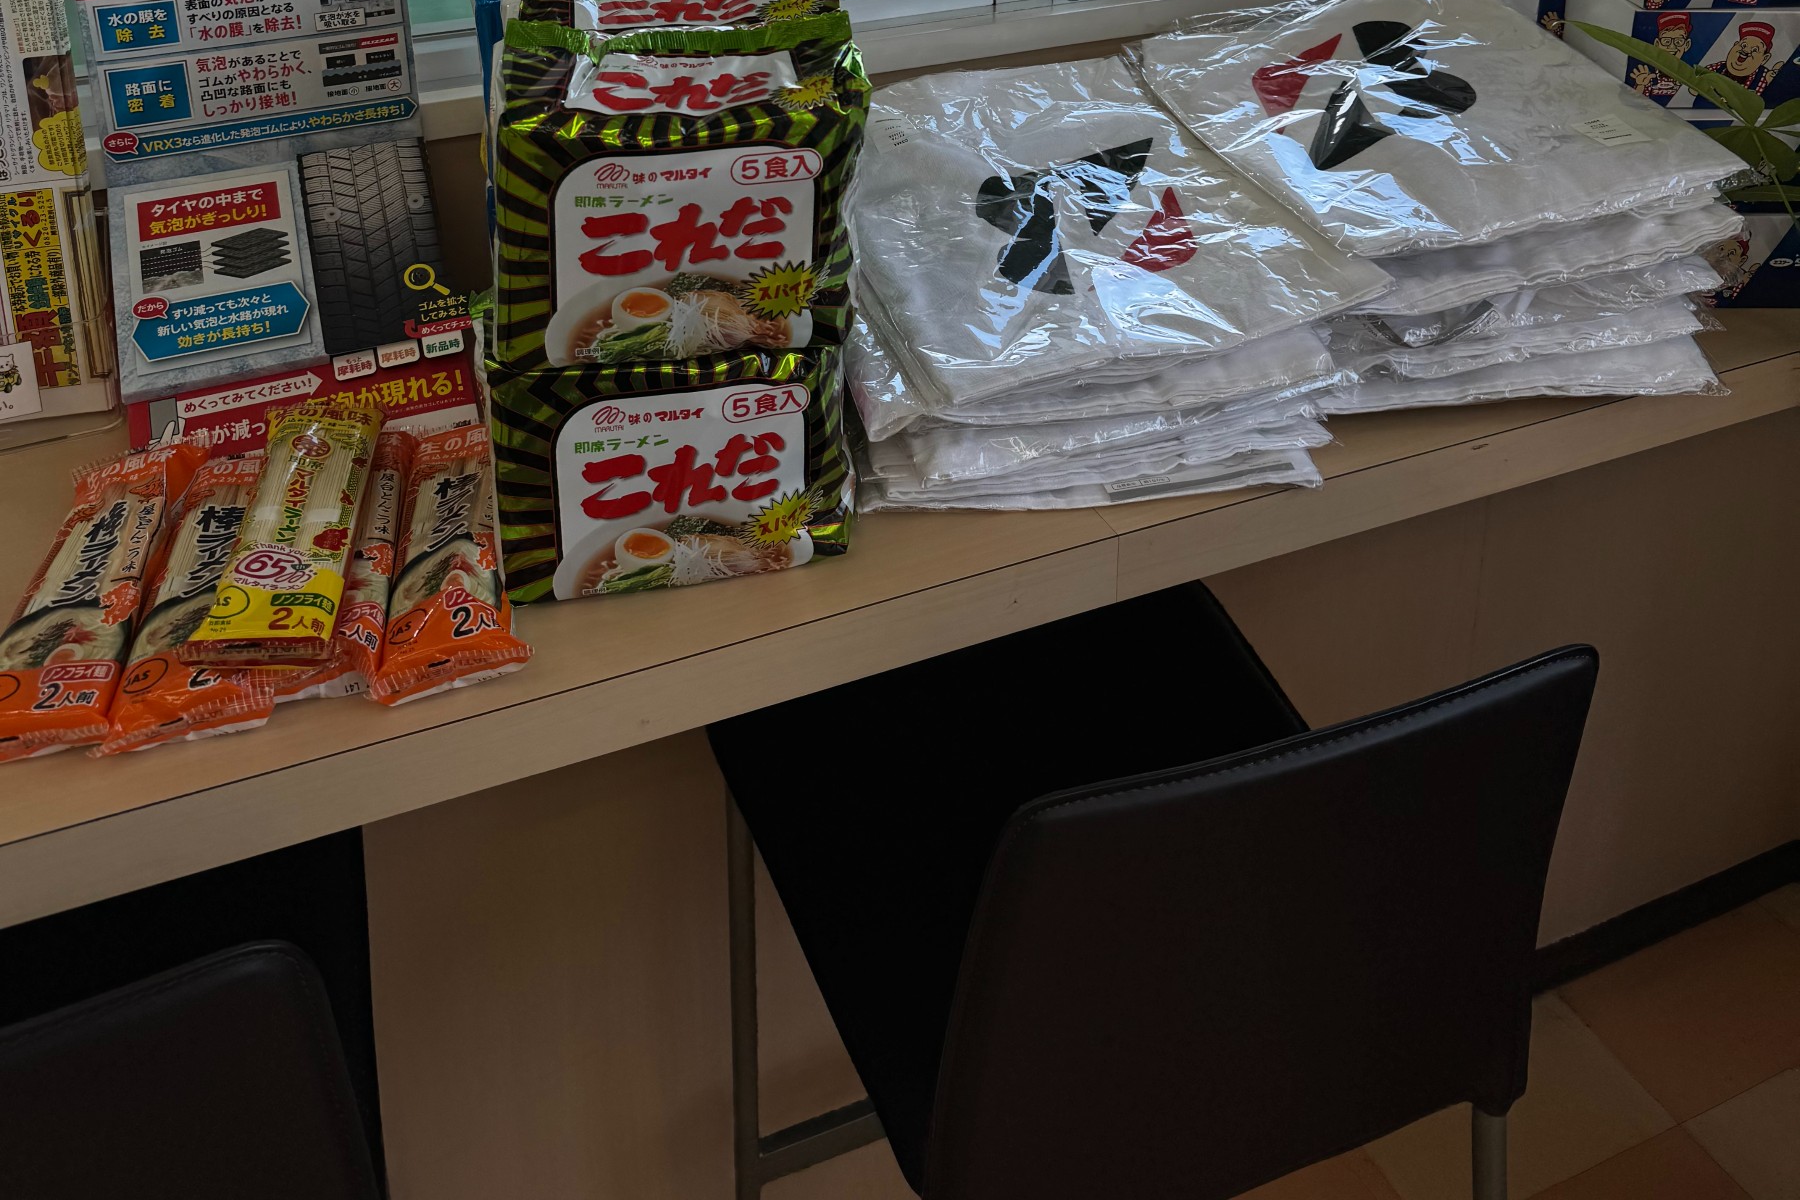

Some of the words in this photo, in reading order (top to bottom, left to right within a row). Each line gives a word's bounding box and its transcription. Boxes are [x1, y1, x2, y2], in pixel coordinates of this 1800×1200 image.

[107, 7, 168, 27] 水の膜を
[186, 1, 294, 25] すべりの原因となる
[318, 10, 361, 24] 気泡が水を
[323, 18, 357, 28] 吸い取る
[196, 50, 302, 74] 気泡があることで
[124, 79, 173, 96] 路面に
[201, 81, 292, 101] 凸凹な路面にも
[591, 71, 770, 112] これだ
[202, 91, 298, 117] しっかり接地!
[107, 137, 134, 149] さらに
[632, 167, 712, 185] 味のマルタイ
[741, 154, 812, 180] 5食入
[151, 188, 264, 218] タイヤの中まで
[574, 192, 674, 208] 即席ラーメン
[37, 190, 51, 246] 0820-23-5253
[149, 203, 267, 235] 気泡がぎっしり!
[577, 195, 794, 275] これだ
[759, 277, 814, 301] スパイス
[137, 300, 165, 315] だから
[171, 293, 272, 320] すり減っても次々と
[157, 305, 289, 336] 新しい気泡と水路が現れ
[177, 321, 271, 349] 効きが長持ち!
[425, 338, 461, 354] 新品時
[183, 377, 313, 413] めくってみてください!
[731, 388, 803, 417] 5食入
[628, 406, 705, 425] 味のマルタイ
[574, 433, 670, 454] 即席ラーメン
[580, 432, 785, 519] これだ
[244, 553, 295, 578] 65
[274, 594, 334, 614] ノンフライ麺
[267, 607, 326, 636] 2人前
[44, 664, 110, 682] ノンフライ麺
[33, 683, 96, 710] 2人前
